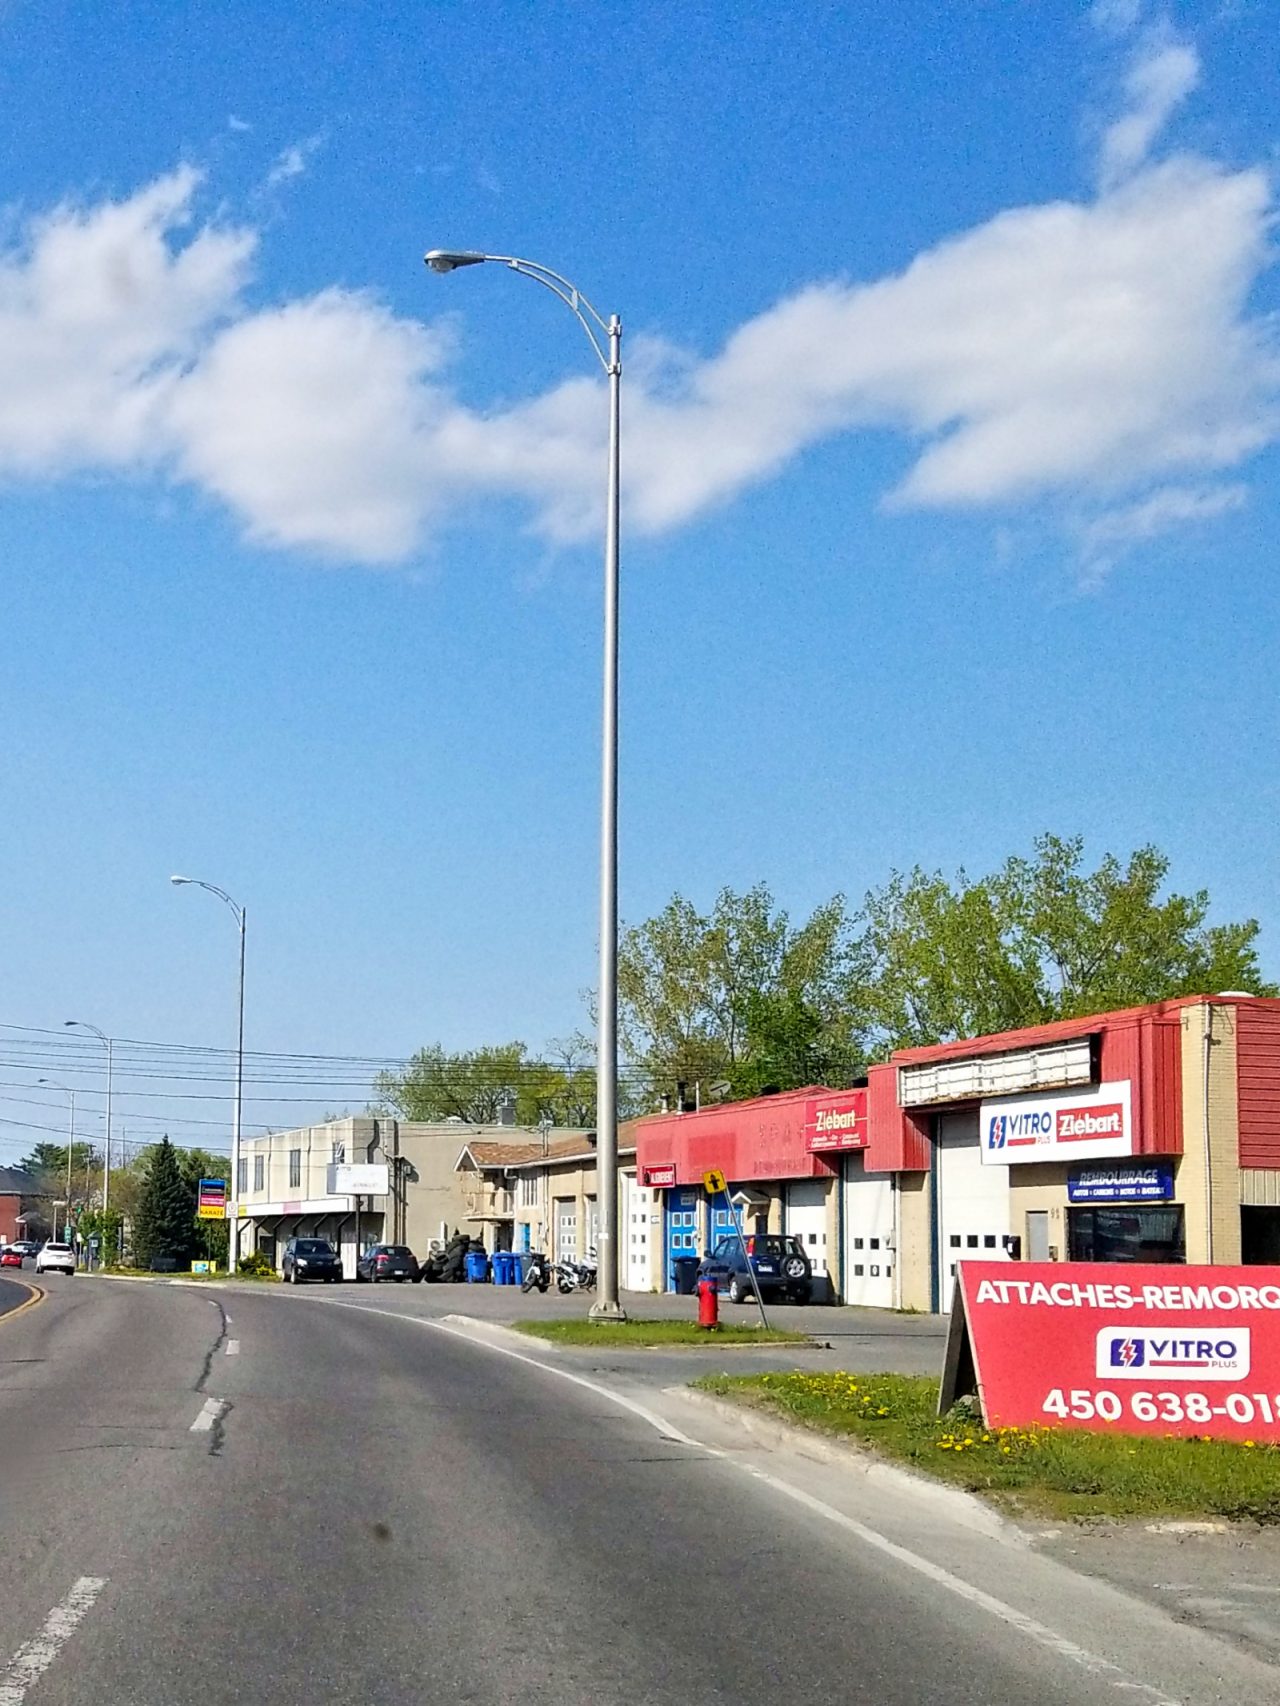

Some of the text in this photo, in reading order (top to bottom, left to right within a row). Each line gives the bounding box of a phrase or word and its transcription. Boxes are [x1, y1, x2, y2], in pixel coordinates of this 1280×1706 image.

[815, 1109, 856, 1132] Ziebart
[1009, 1112, 1121, 1136] VITRO Ziebart
[1079, 1169, 1158, 1186] REMBOURRAGE
[1149, 1340, 1237, 1359] VITRO
[1211, 1360, 1238, 1369] PLUS
[1042, 1389, 1280, 1424] 450 638-01
